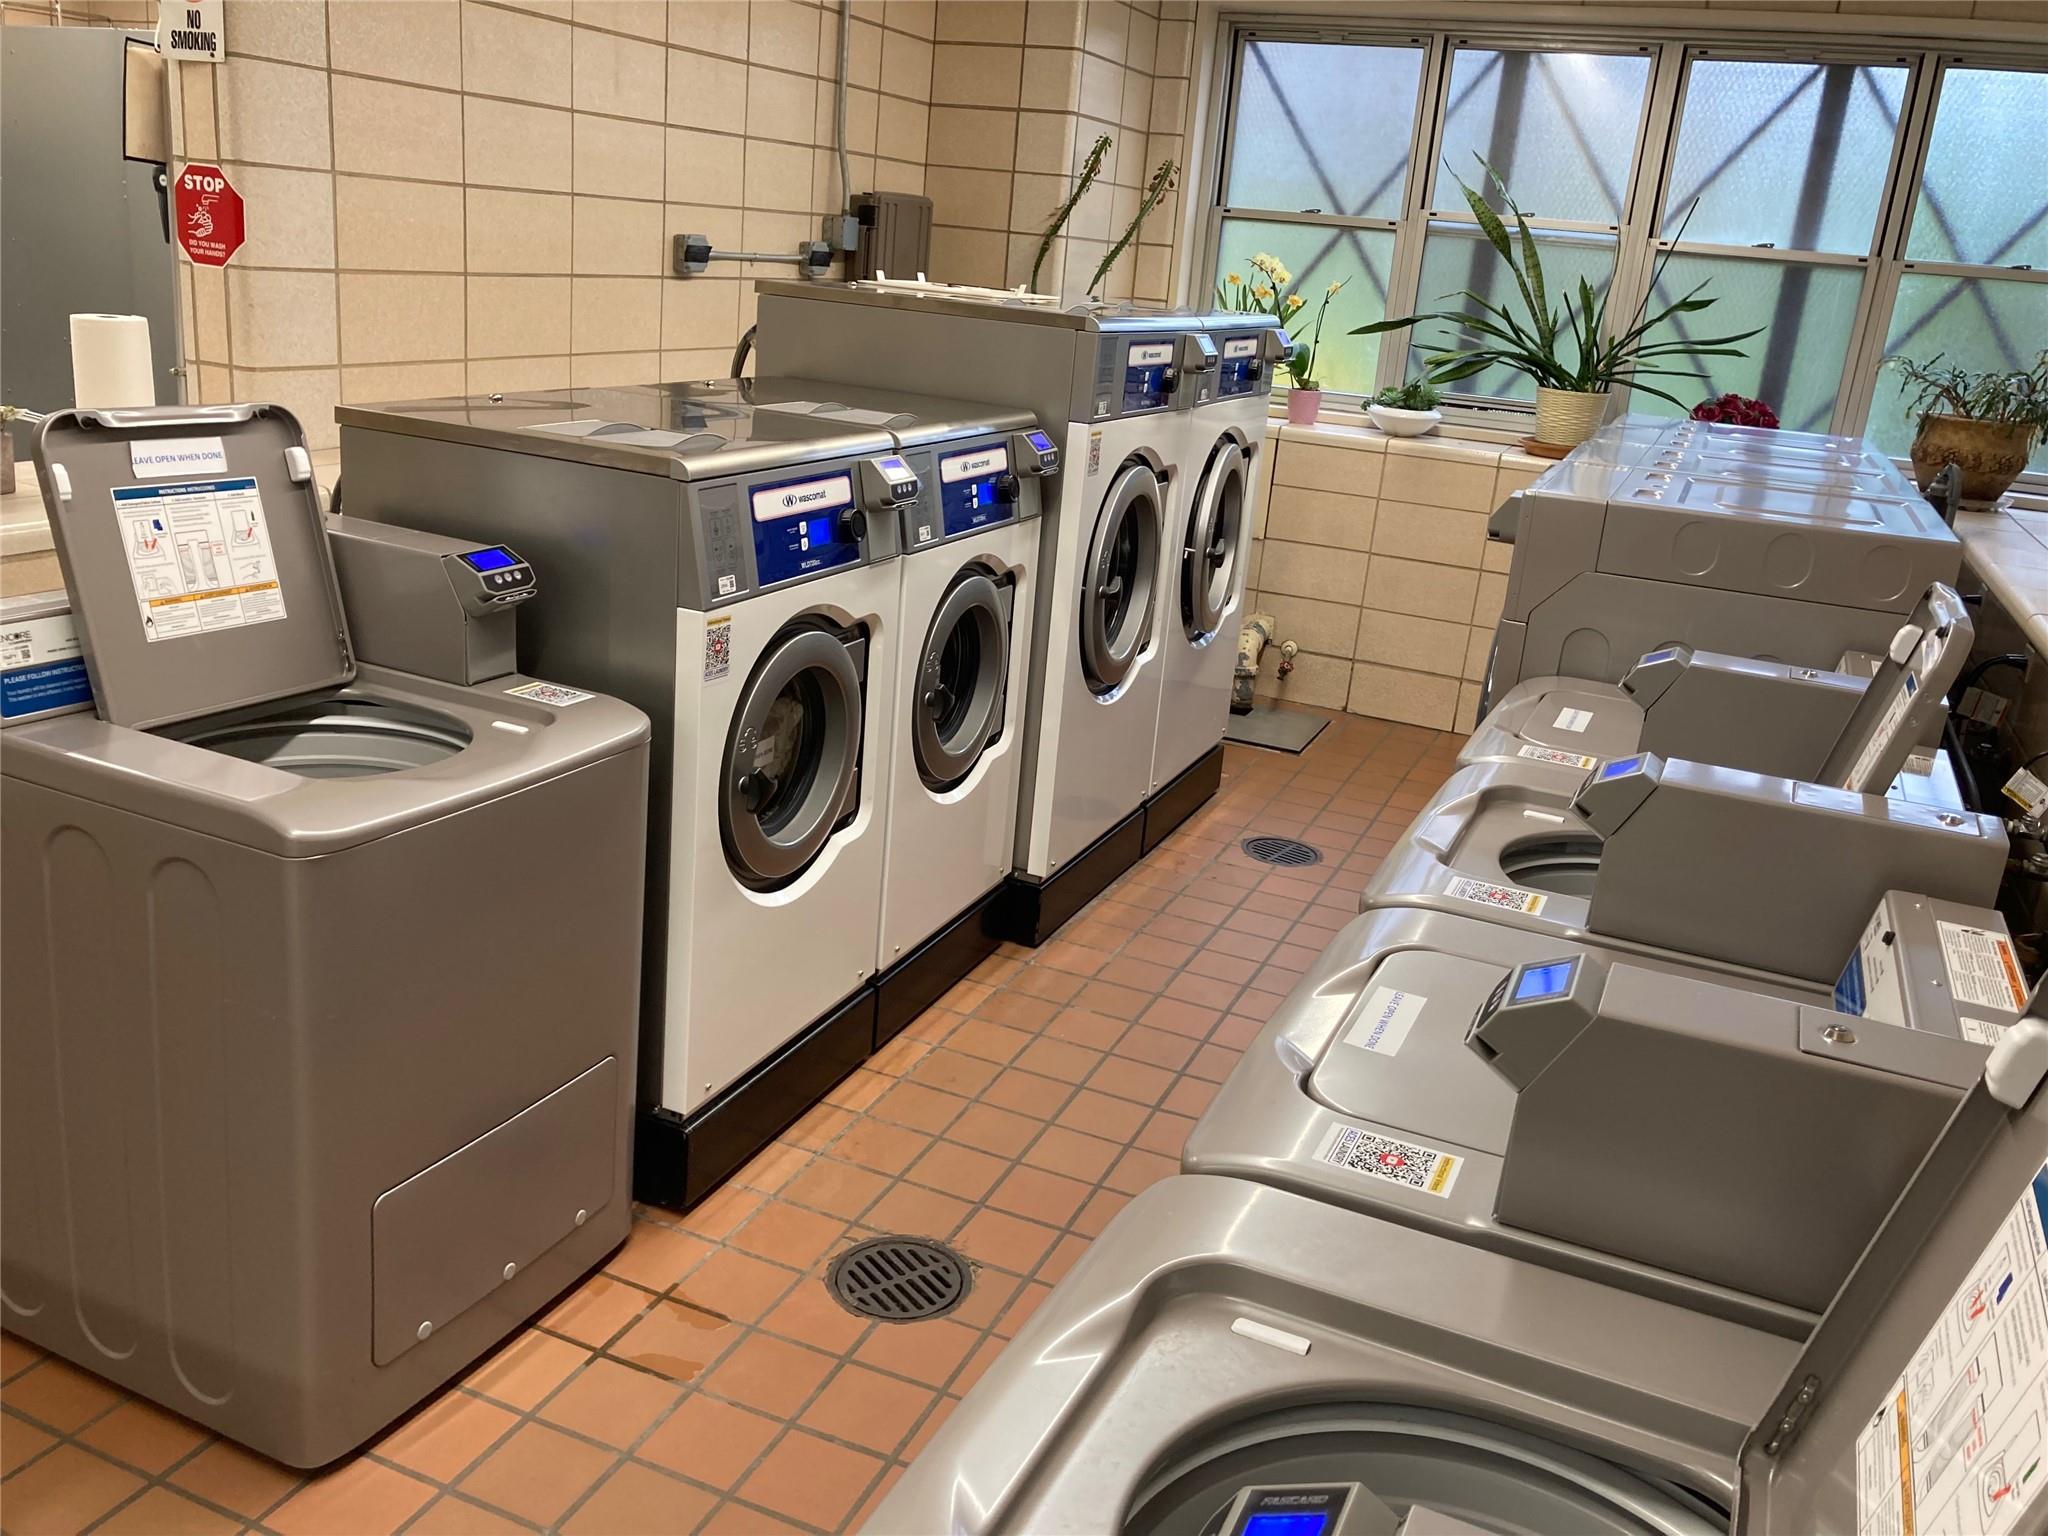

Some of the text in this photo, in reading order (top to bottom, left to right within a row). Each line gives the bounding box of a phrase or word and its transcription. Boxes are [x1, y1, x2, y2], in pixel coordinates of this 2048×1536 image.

[186, 9, 201, 29] NO
[171, 30, 216, 51] SMOKING
[184, 174, 224, 192] STOP
[188, 238, 225, 250] DID YOU WASH
[190, 247, 225, 258] YOUR HANDS?
[155, 454, 176, 464] OPEN
[176, 453, 201, 462] WHEN
[202, 451, 223, 460] DONE
[798, 489, 826, 503] wascomat
[4, 674, 27, 685] PLEASE
[27, 670, 51, 681] FOLLOW
[1374, 1018, 1389, 1036] WHEN
[1364, 1034, 1381, 1050] DONE
[1332, 1142, 1351, 1165] LAUNDRY
